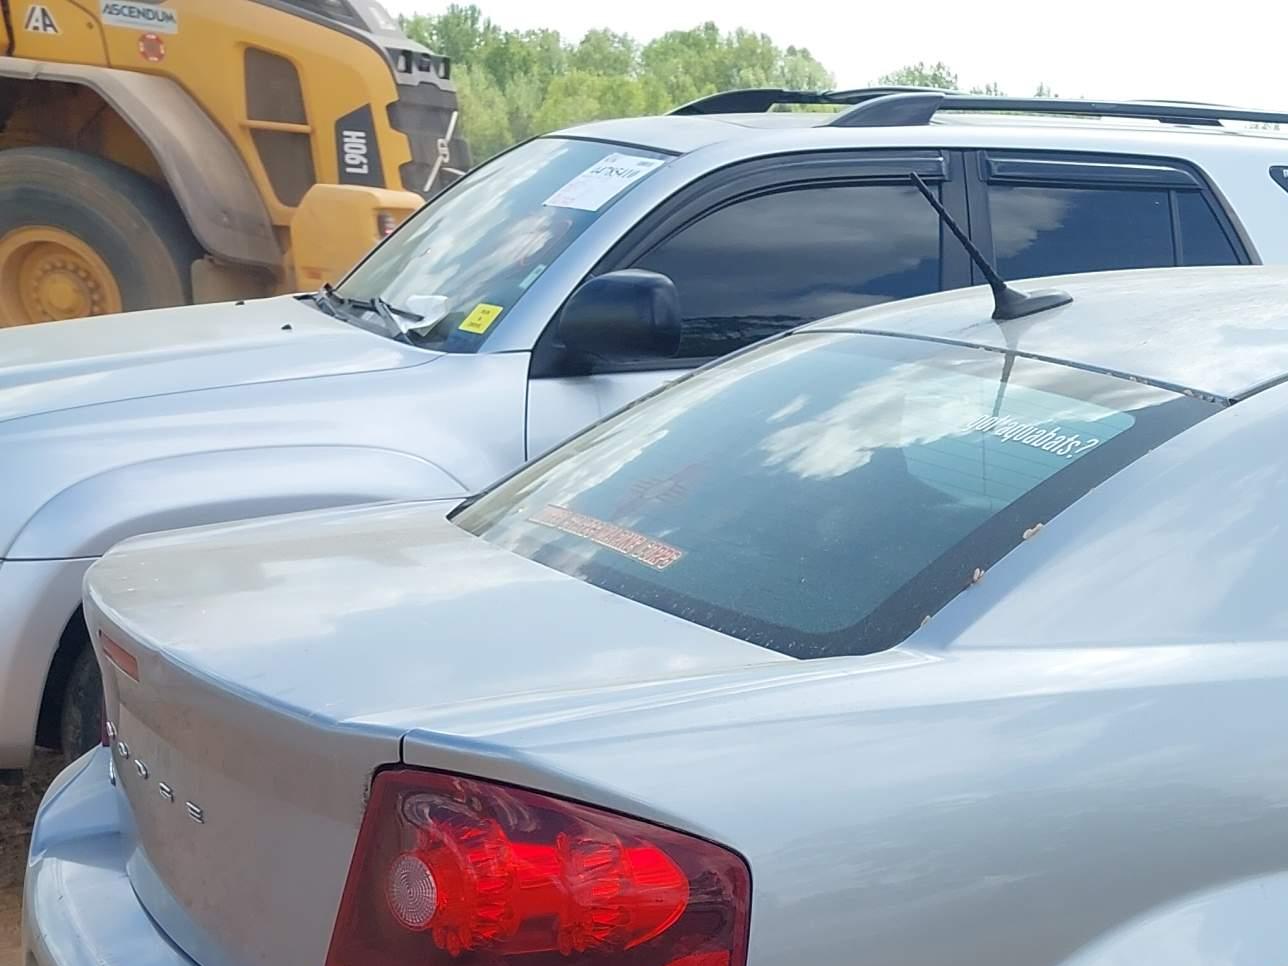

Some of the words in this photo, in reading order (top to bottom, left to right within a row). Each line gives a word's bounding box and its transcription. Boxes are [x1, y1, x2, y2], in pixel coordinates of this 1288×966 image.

[103, 4, 176, 23] ASCENDUM
[343, 130, 369, 174] L90H
[995, 421, 1099, 458] aquabats?
